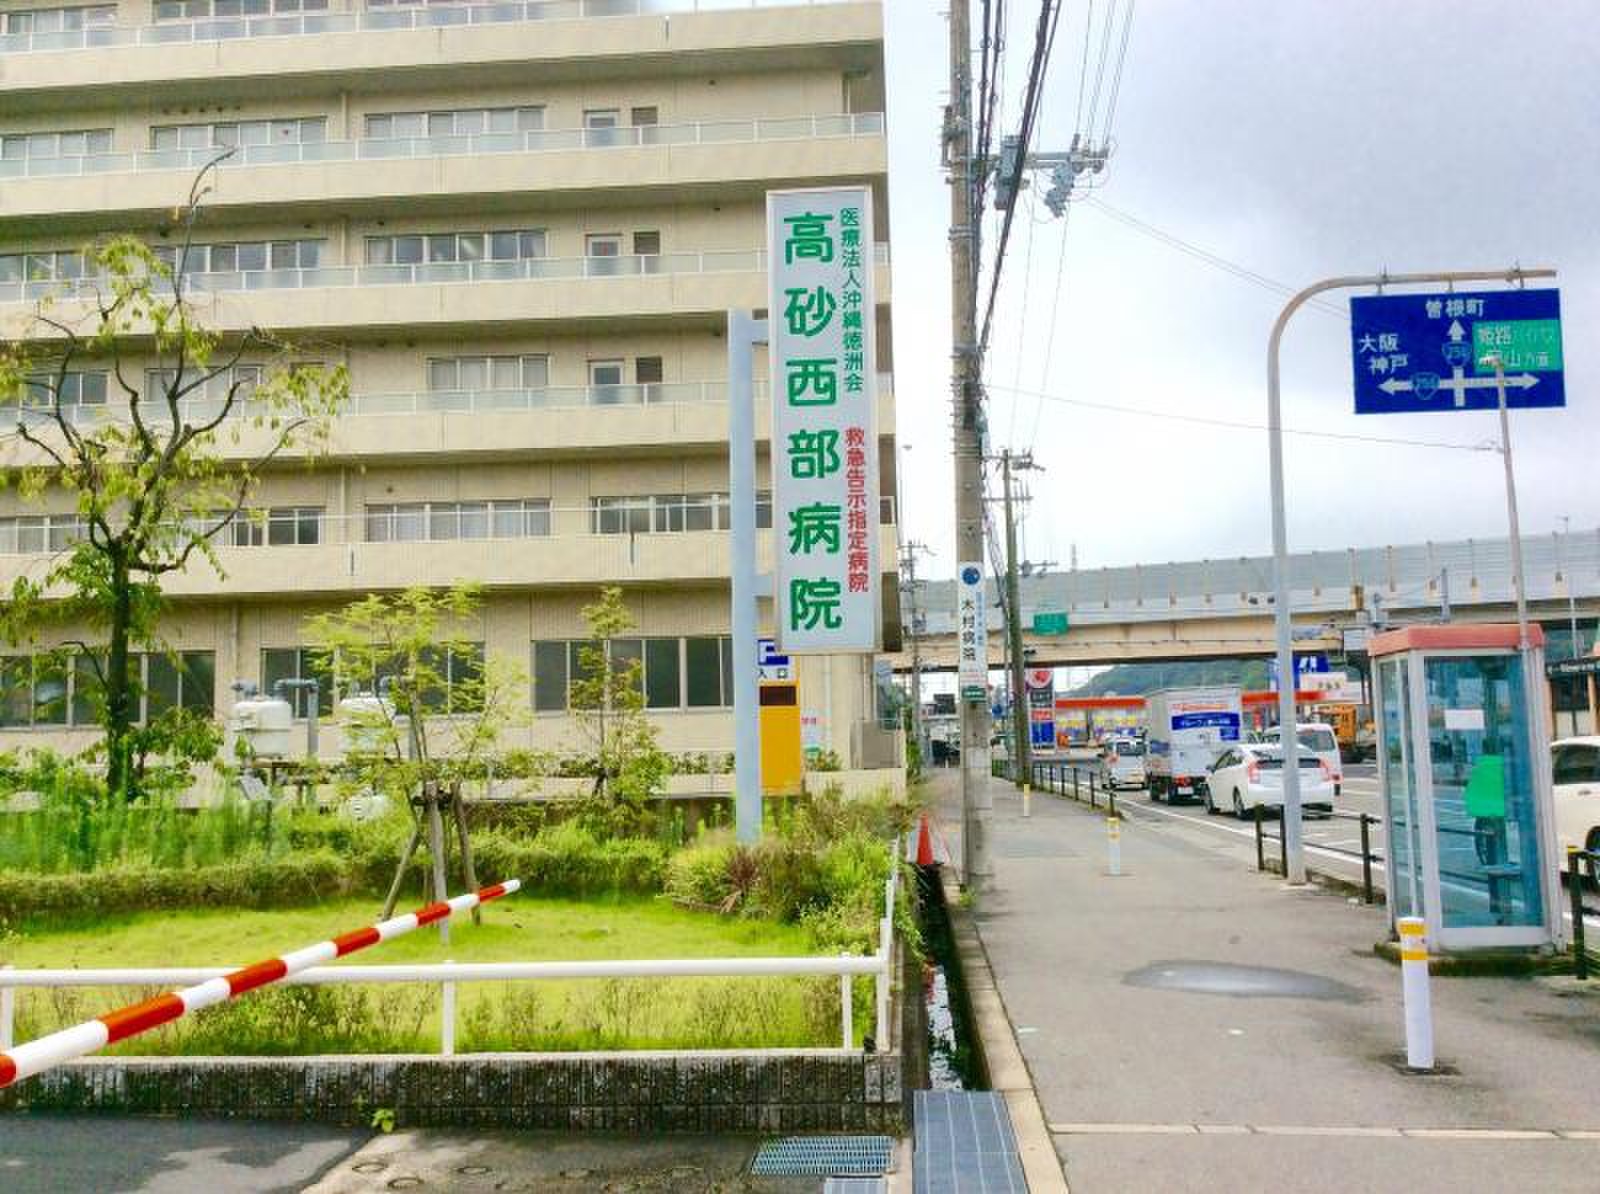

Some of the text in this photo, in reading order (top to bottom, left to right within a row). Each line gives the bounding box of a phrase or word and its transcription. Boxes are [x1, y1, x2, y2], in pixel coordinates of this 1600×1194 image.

[1359, 333, 1399, 353] 大阪
[1369, 353, 1409, 376] 神戸
[783, 211, 843, 631] 高砂西部病院
[844, 426, 869, 593] 救急告示指定病院
